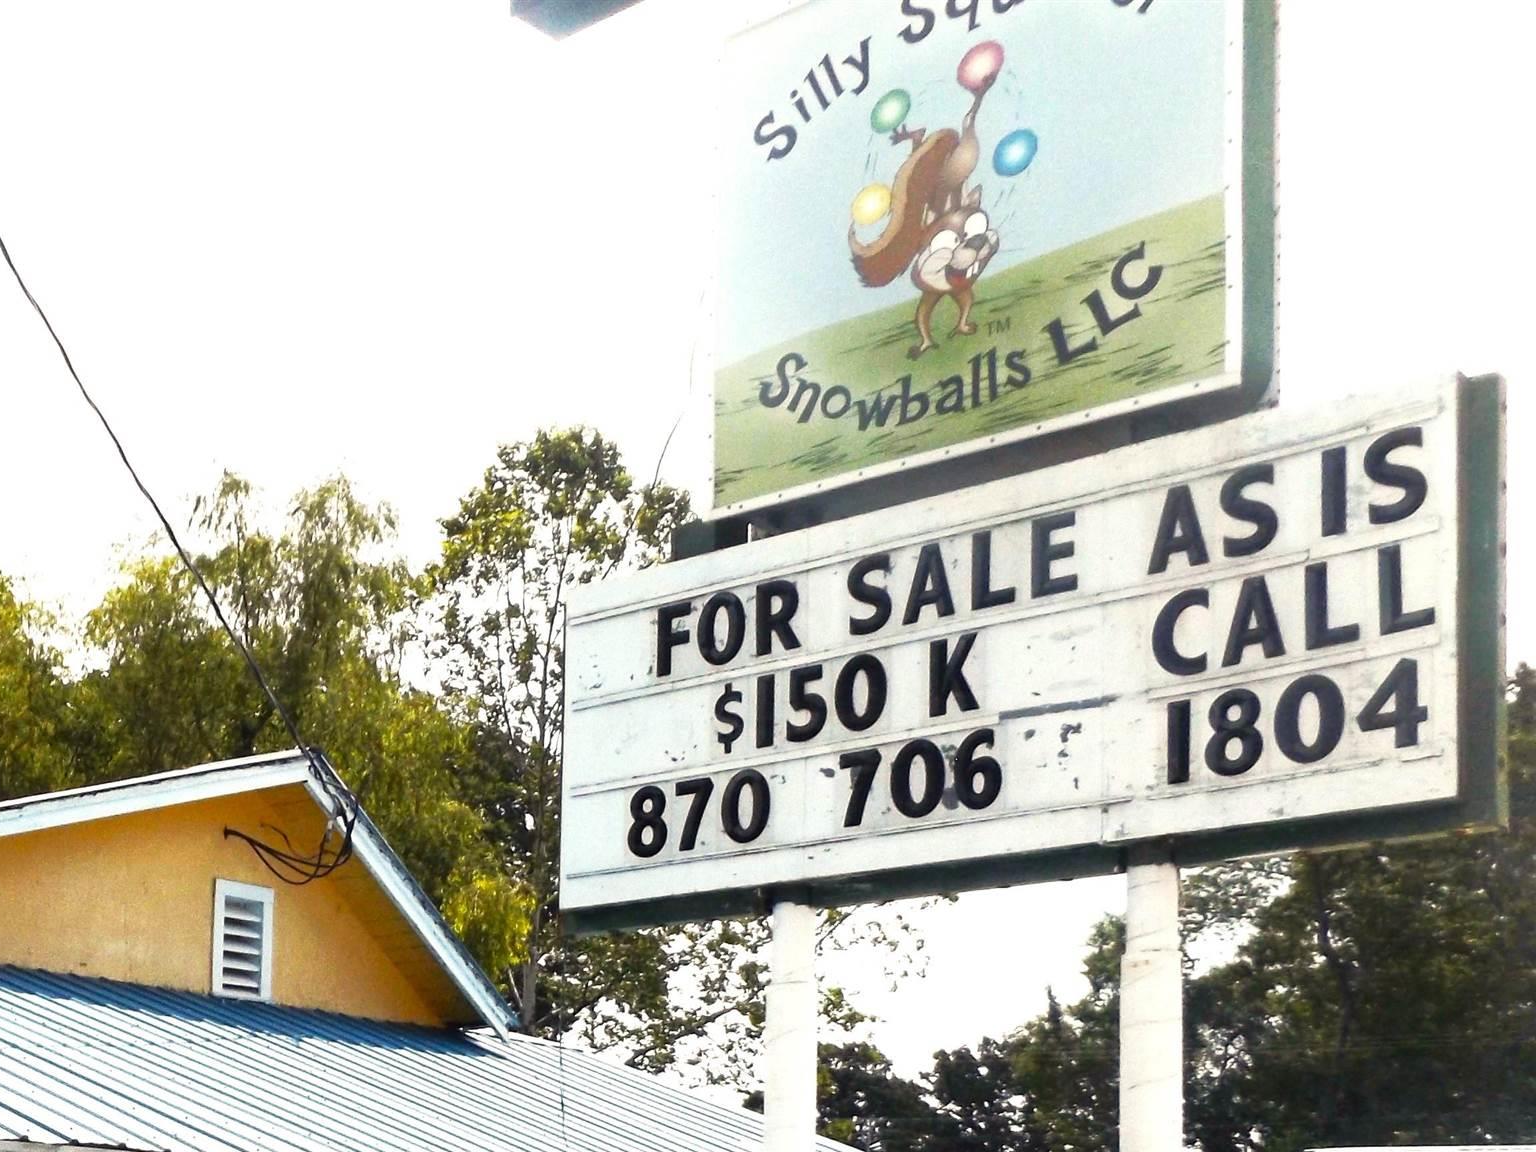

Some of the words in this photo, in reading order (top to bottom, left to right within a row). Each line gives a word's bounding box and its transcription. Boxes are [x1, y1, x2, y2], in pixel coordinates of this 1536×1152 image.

[752, 35, 873, 162] Silly
[757, 348, 1032, 432] Snowballs
[1046, 240, 1165, 366] LLC
[655, 578, 804, 678] FOR
[846, 510, 1080, 637] SALE
[1146, 463, 1279, 576] AS
[1320, 426, 1428, 538] IS
[713, 652, 889, 755] $150
[928, 630, 982, 719] K
[1151, 543, 1437, 677] CALL
[626, 767, 772, 860] 870
[837, 726, 1004, 829] 706
[1166, 657, 1429, 786] 1804
